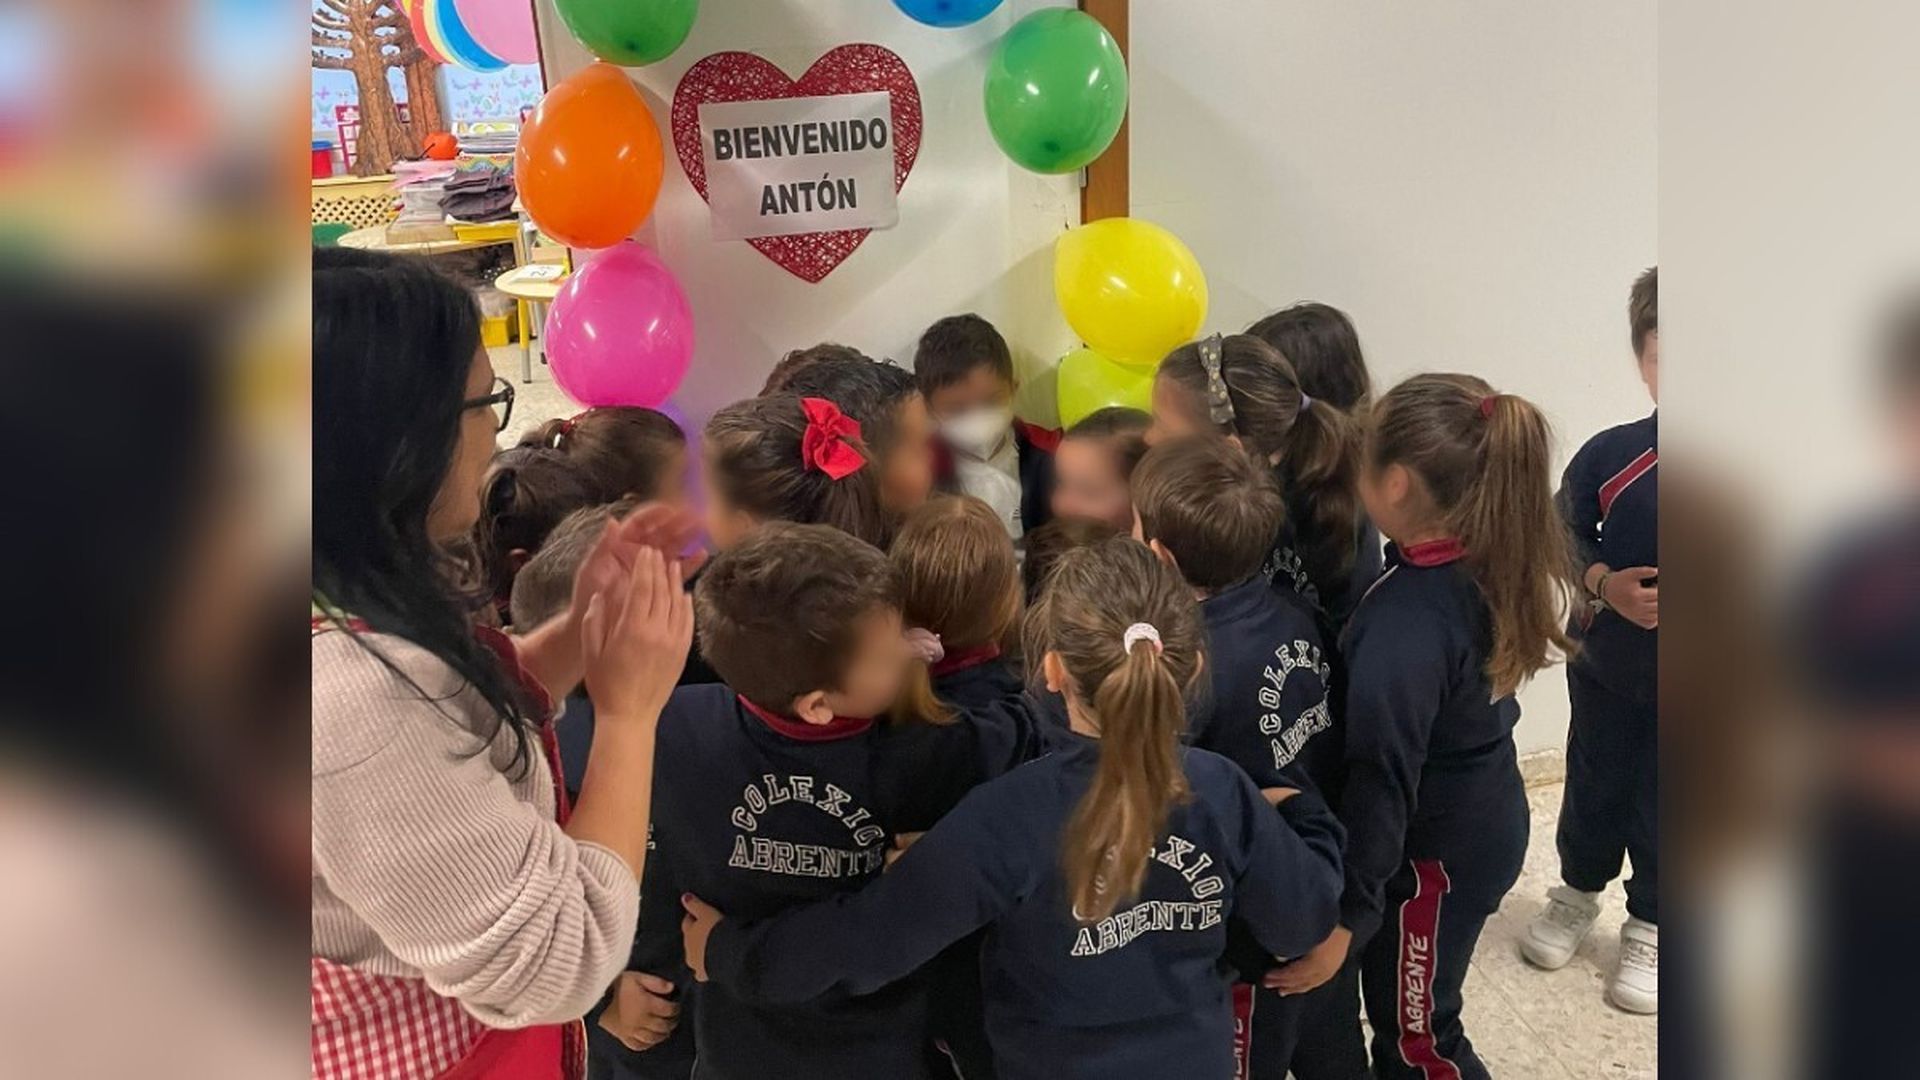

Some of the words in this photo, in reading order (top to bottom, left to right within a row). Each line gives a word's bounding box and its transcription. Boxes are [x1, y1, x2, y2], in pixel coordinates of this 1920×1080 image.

[712, 117, 888, 161] BIENVENIDO
[760, 172, 857, 216] ANTÓN
[1070, 899, 1223, 957] ABRENTE
